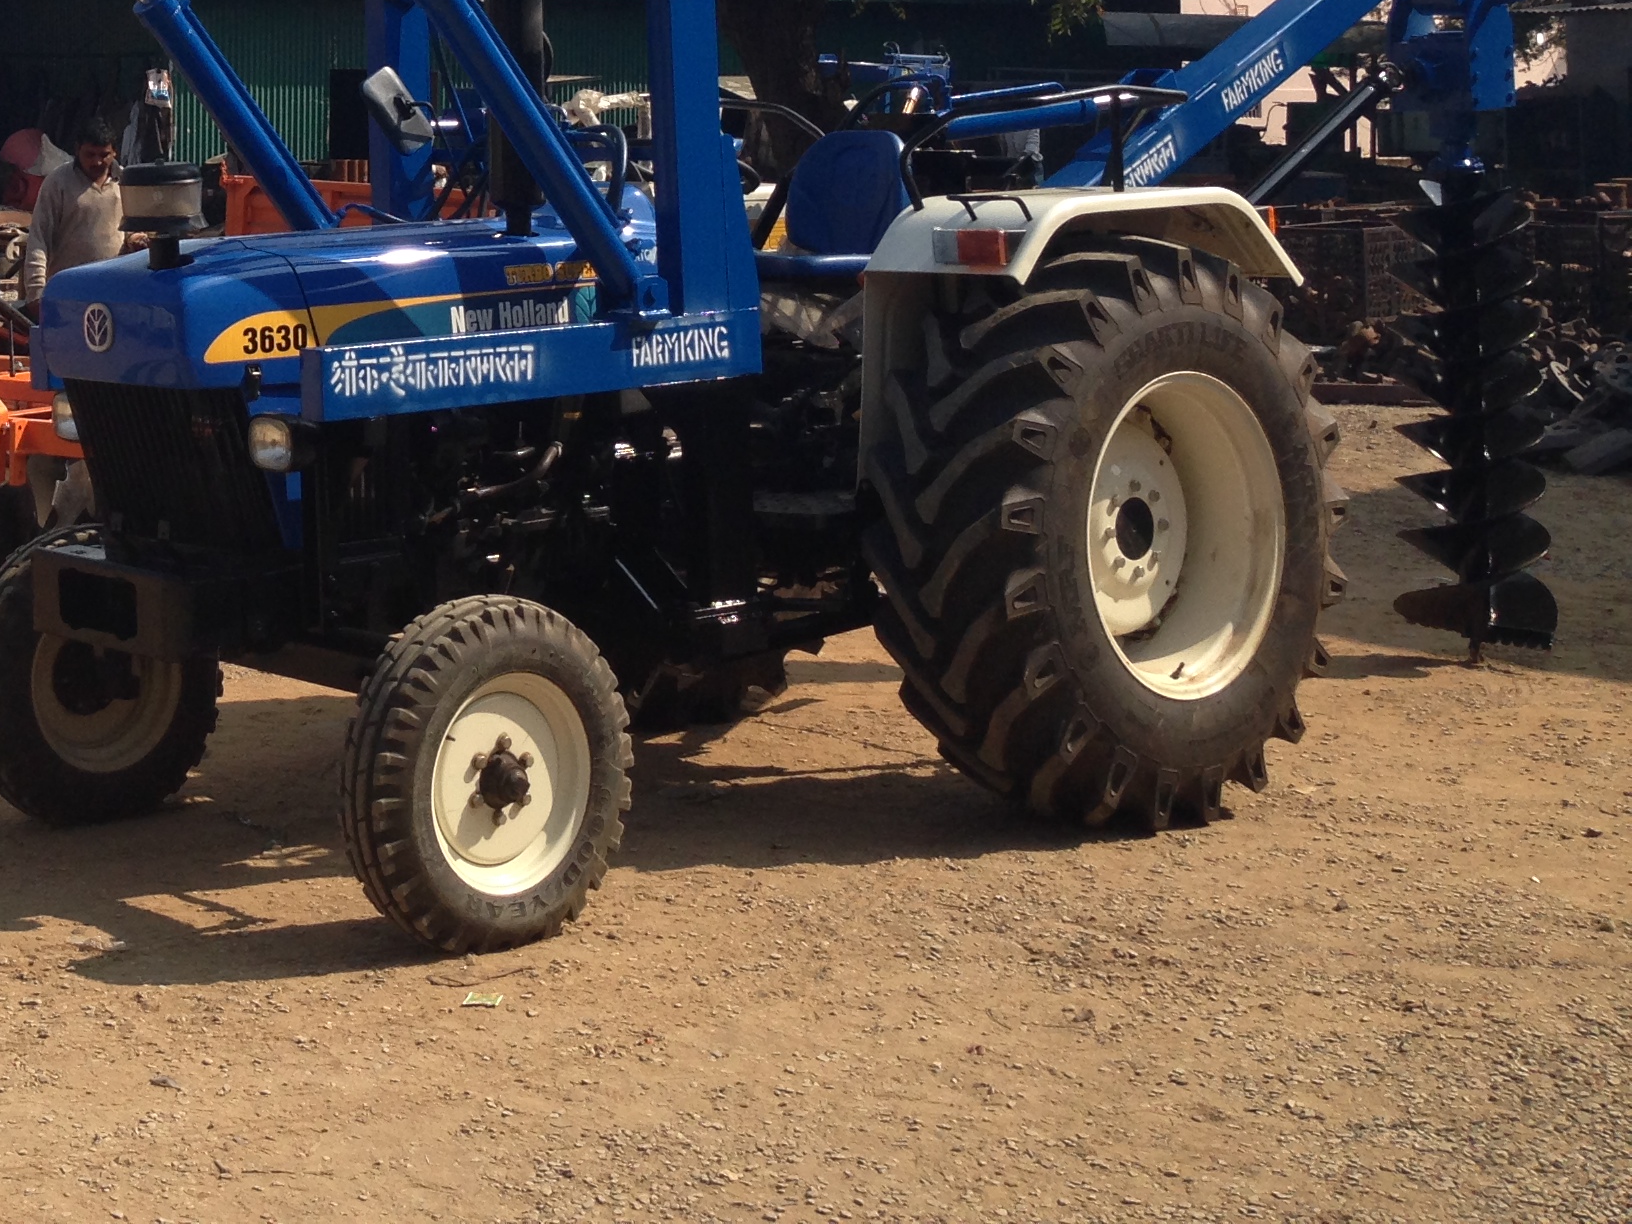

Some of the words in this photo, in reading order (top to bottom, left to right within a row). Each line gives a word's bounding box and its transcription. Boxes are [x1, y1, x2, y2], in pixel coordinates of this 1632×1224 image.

[1221, 48, 1284, 113] FARMKING
[450, 305, 494, 334] New
[498, 296, 568, 329] Holland
[242, 324, 307, 355] 3630
[632, 326, 730, 367] FARMKING
